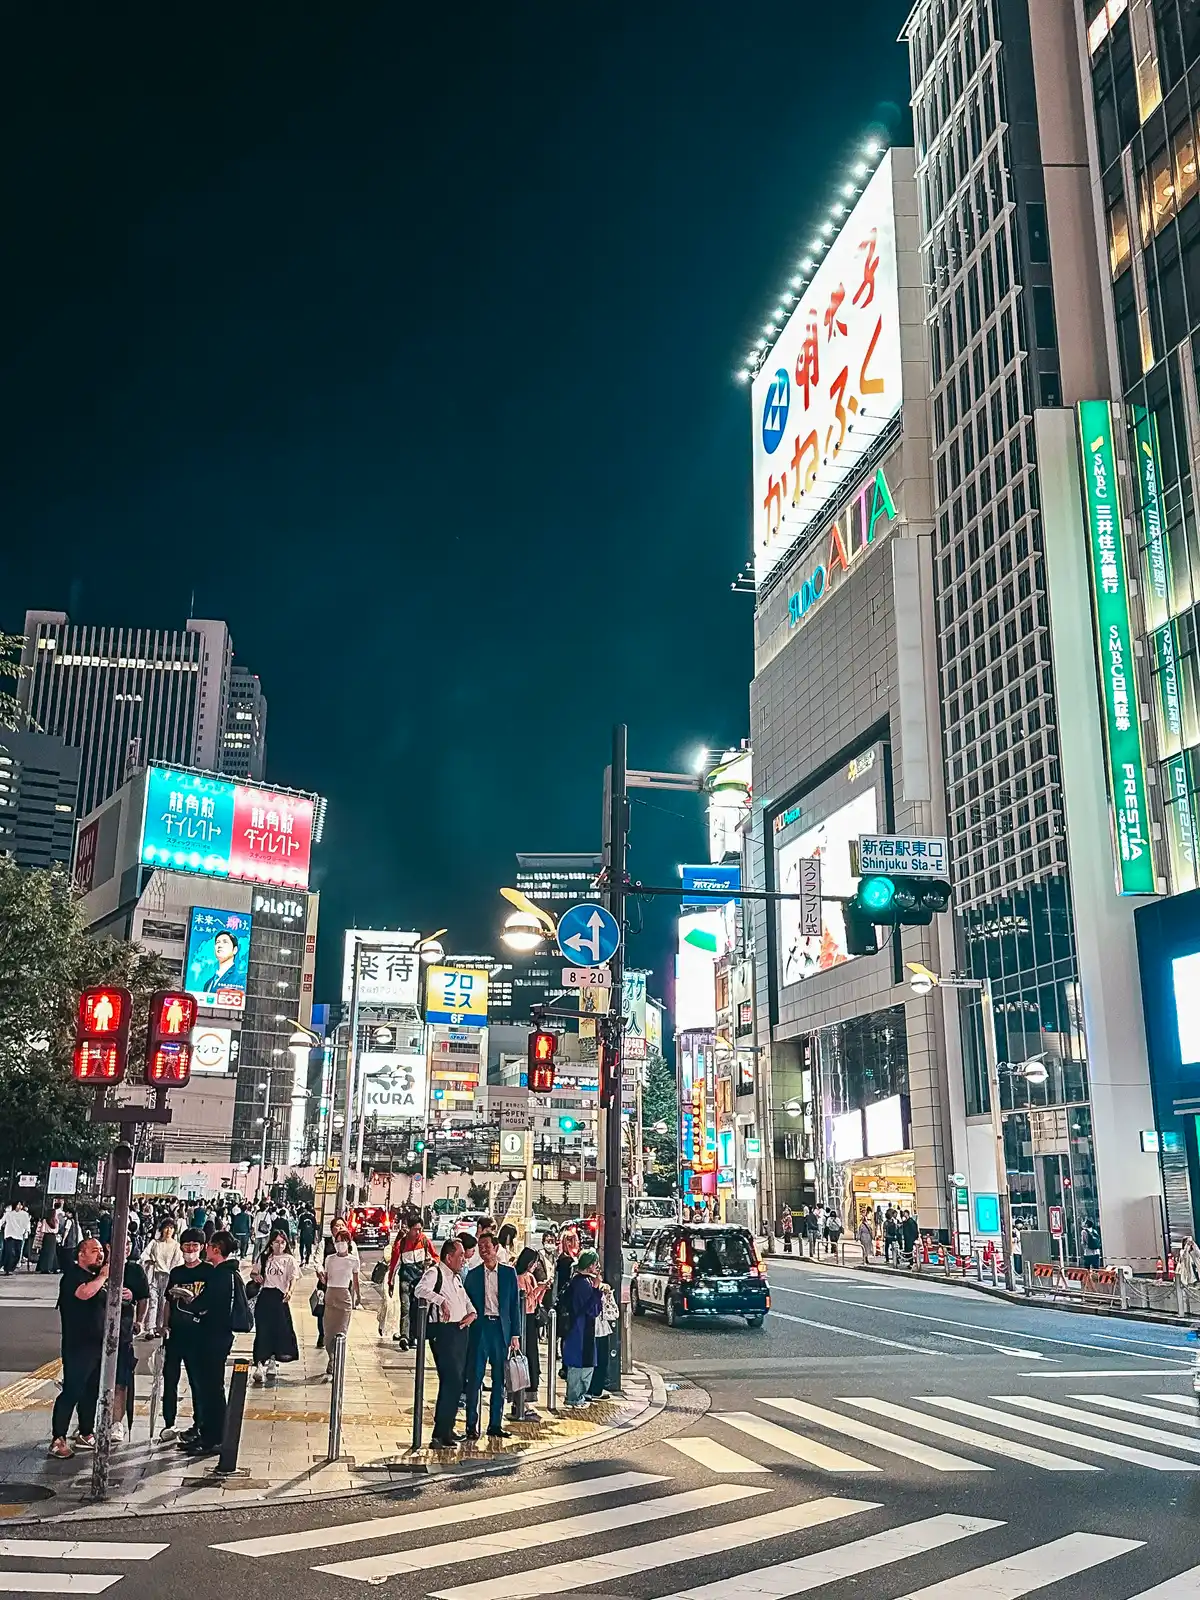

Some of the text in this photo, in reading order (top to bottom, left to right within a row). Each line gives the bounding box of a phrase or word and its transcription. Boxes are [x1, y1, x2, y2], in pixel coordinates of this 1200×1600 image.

[795, 227, 880, 412] 明太子
[764, 314, 885, 546] かねふく
[825, 468, 899, 591] ALTA
[1093, 453, 1119, 594] SMBC 三井住友銀行
[160, 812, 222, 841] ダイレクト
[79, 829, 95, 861] UNI
[243, 828, 300, 856] ダイレクト
[862, 839, 943, 858] 新宿駅東口
[862, 857, 908, 871] Shinjuku
[804, 861, 818, 934] スクランブル式
[444, 971, 473, 990] プロ
[218, 994, 241, 1005] ECC
[443, 991, 472, 1009] ミス
[450, 1013, 465, 1024] 6F
[367, 1092, 415, 1105] KURA
[505, 1109, 525, 1118] OPEN
